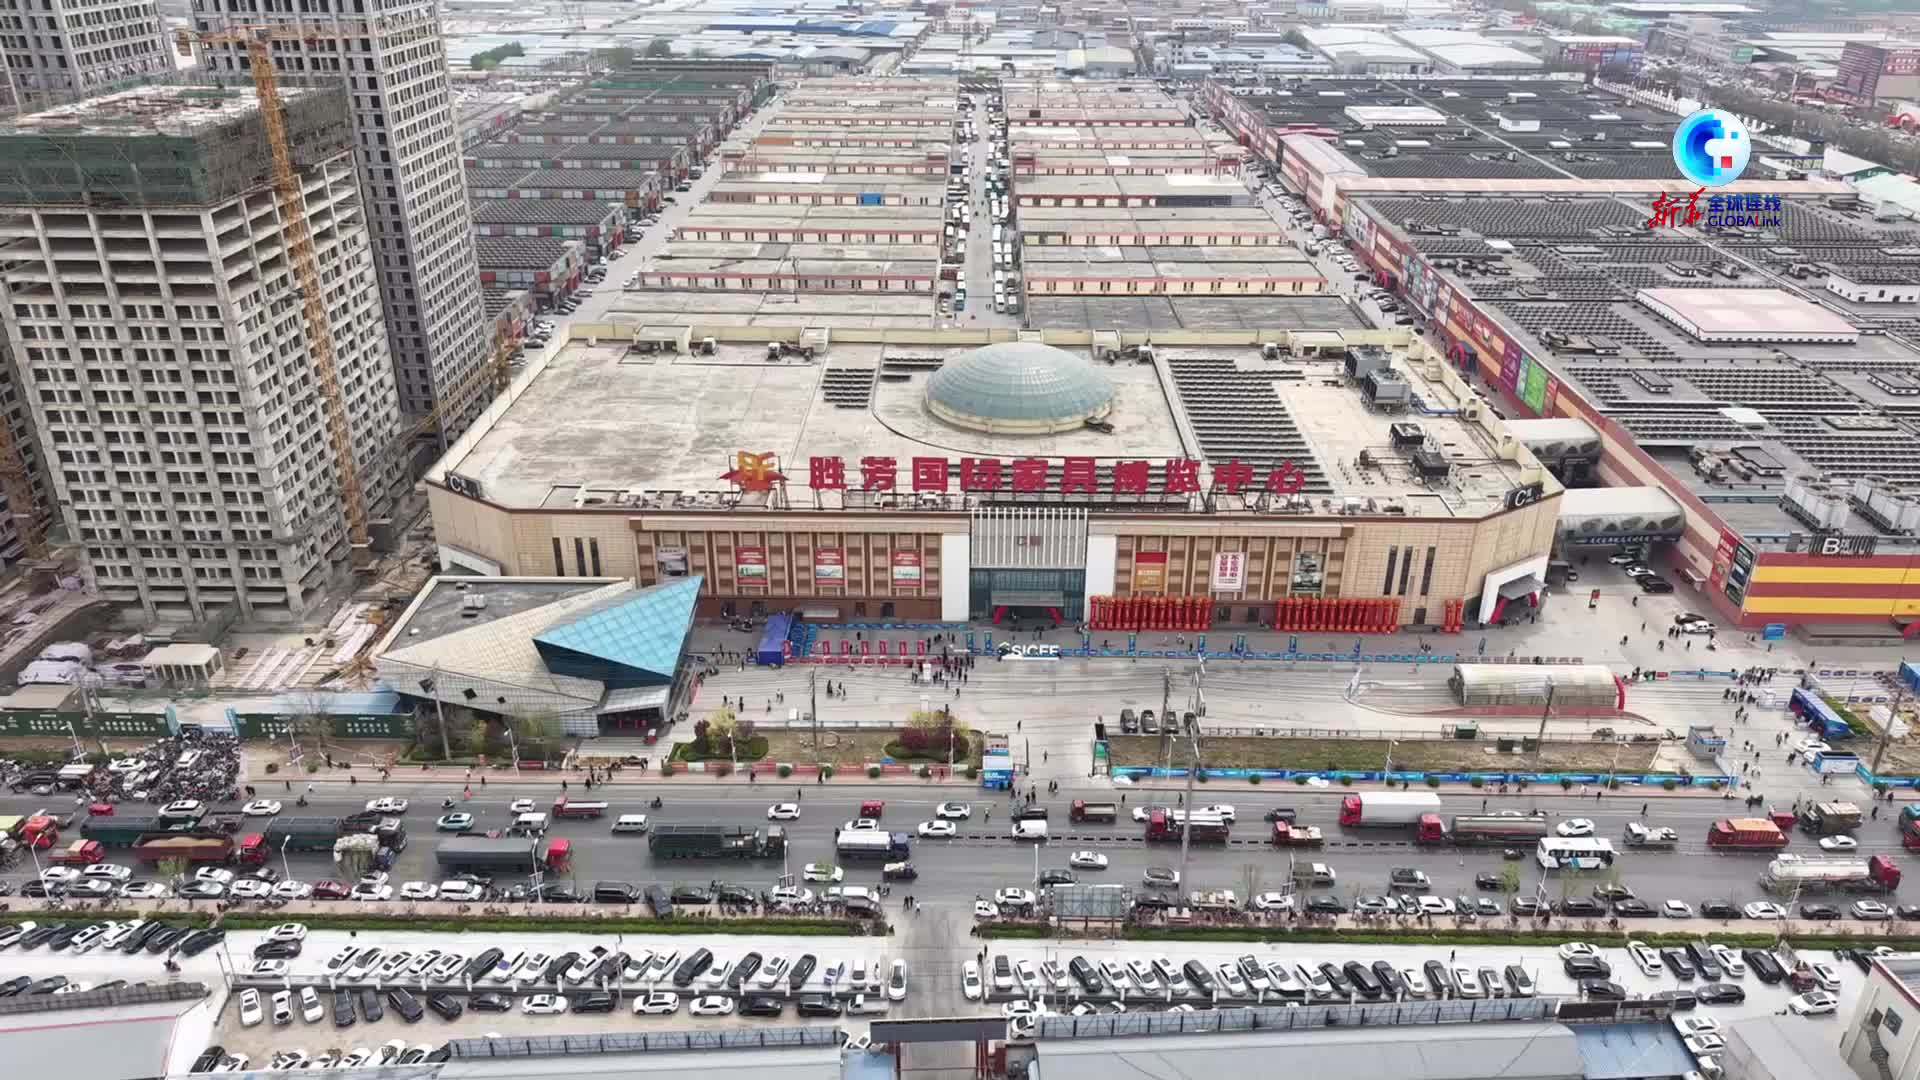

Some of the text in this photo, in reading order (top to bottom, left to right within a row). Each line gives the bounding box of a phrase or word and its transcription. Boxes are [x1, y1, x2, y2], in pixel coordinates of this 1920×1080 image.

[809, 456, 1305, 495] 胜芳国际家具博览中心
